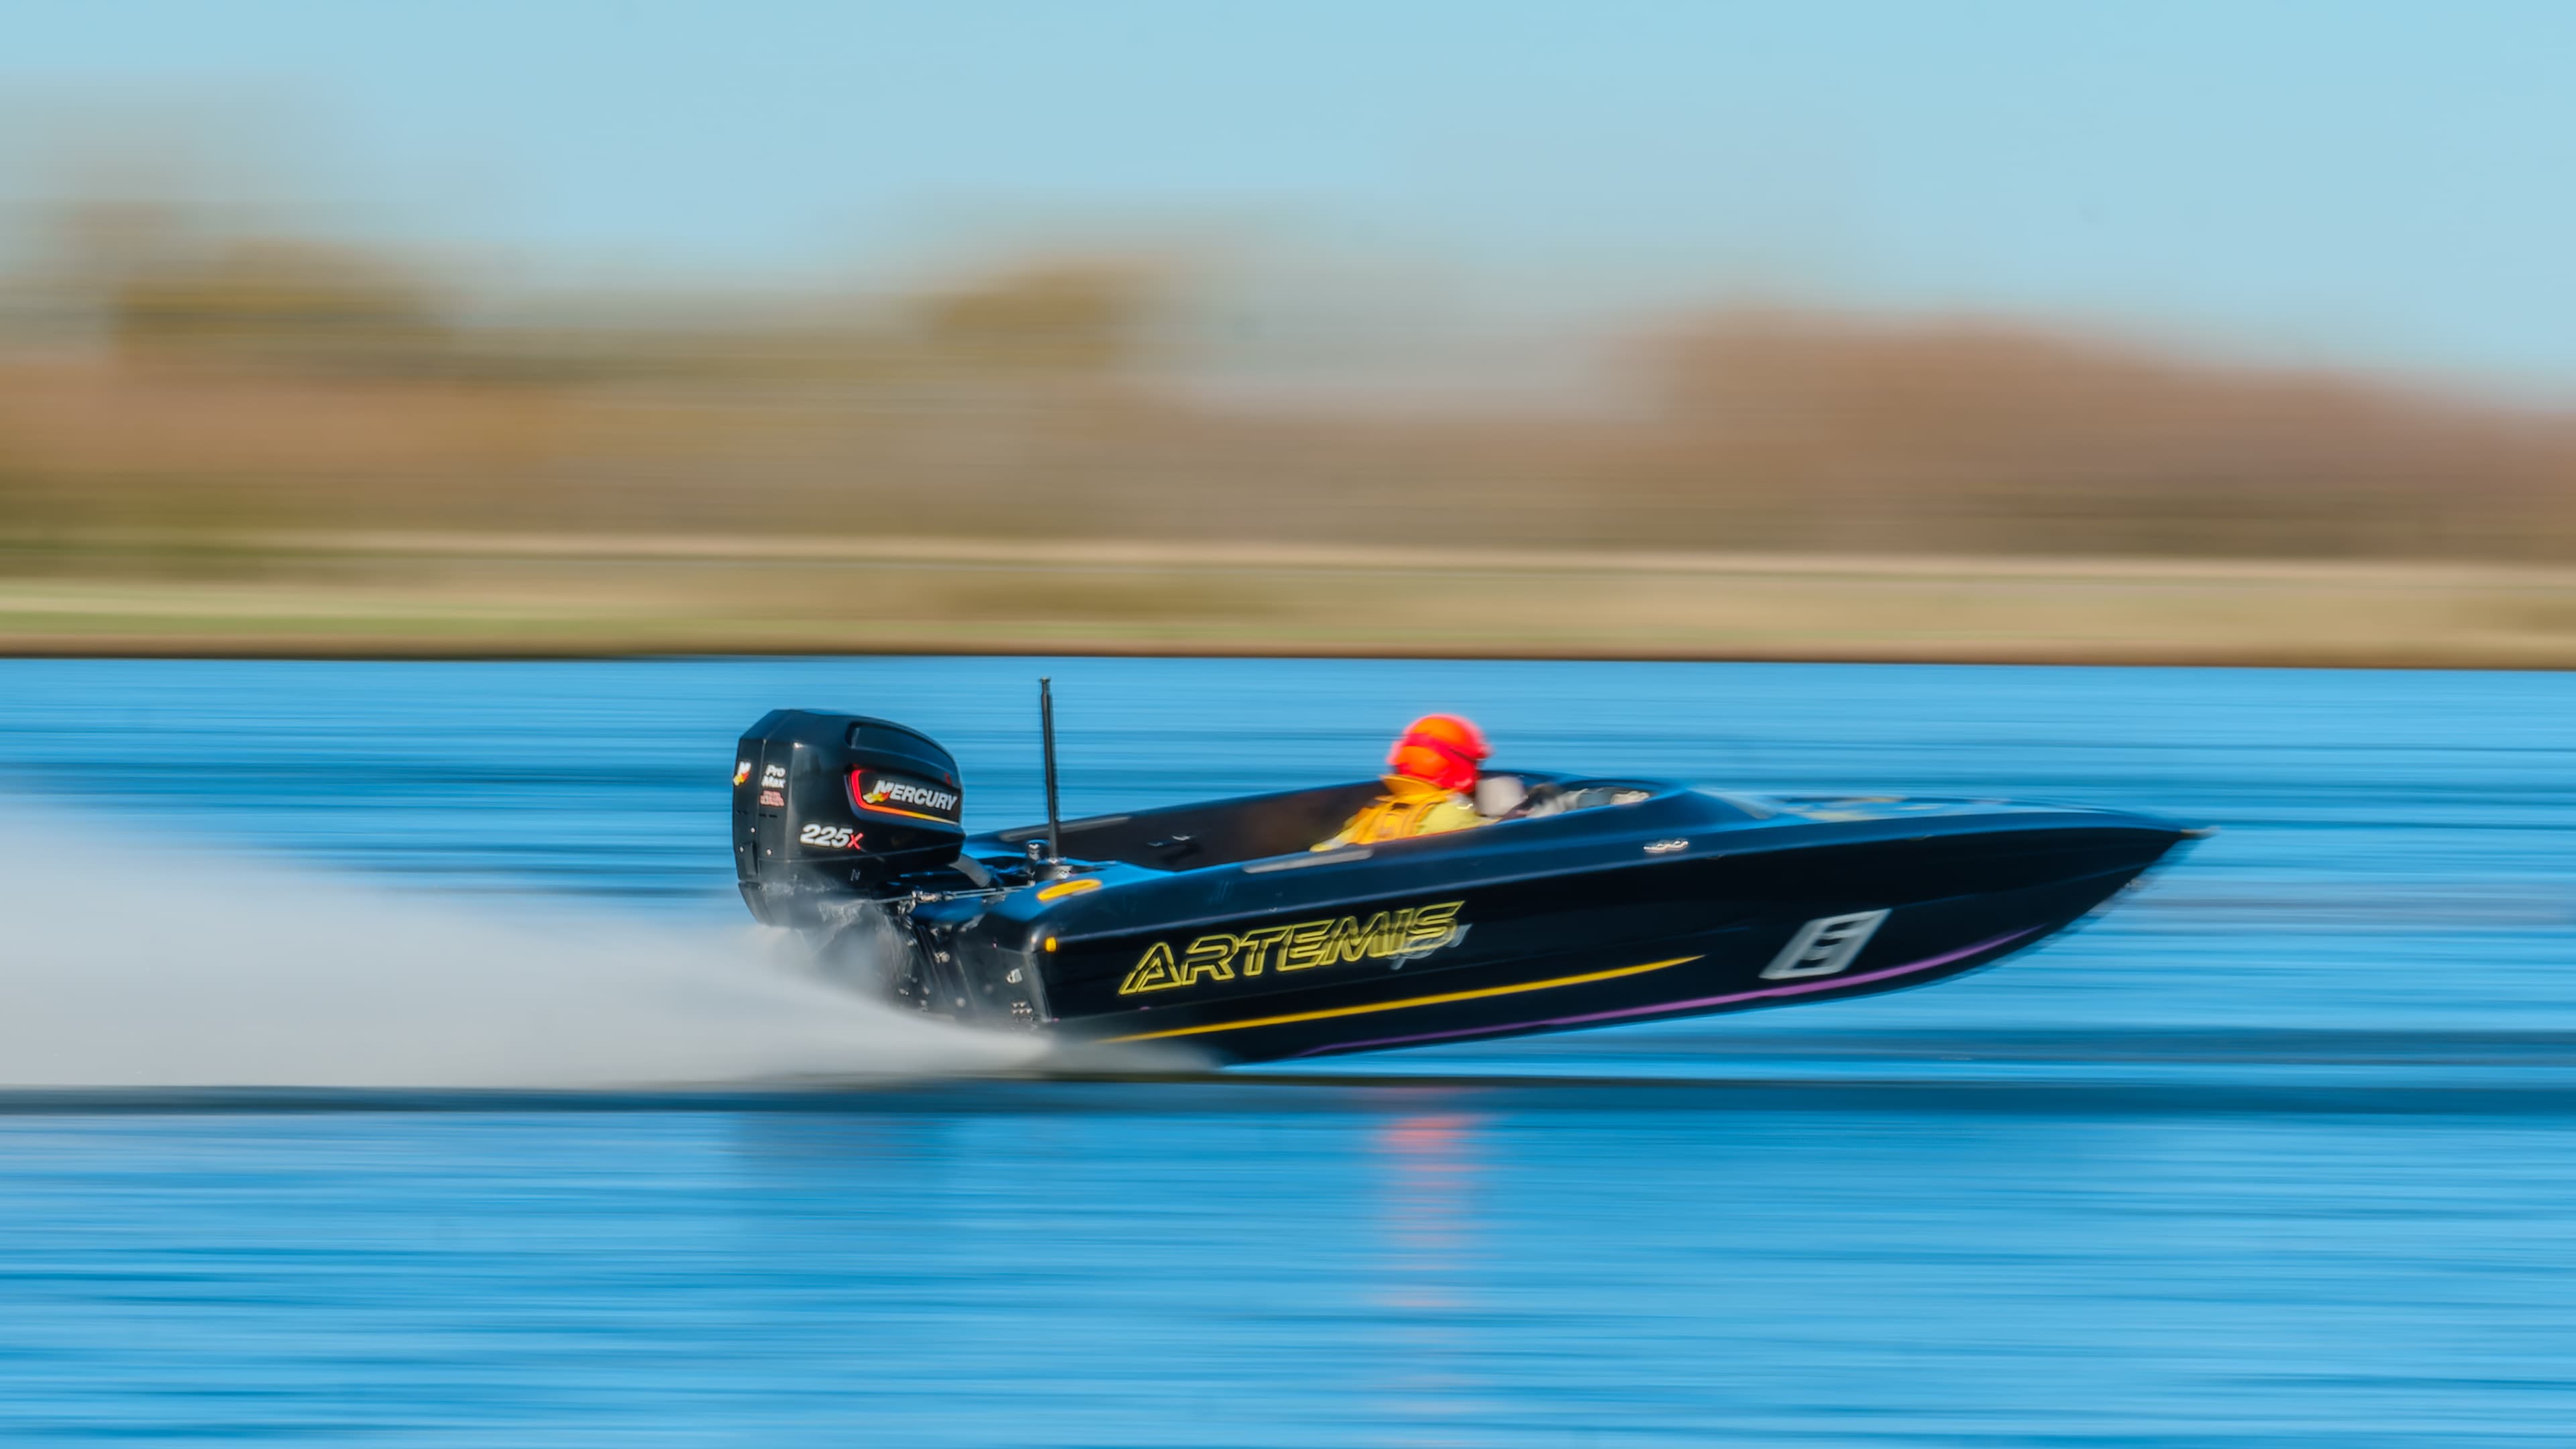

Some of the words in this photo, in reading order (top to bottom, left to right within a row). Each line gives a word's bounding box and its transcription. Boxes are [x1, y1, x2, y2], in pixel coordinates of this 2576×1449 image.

[765, 764, 786, 777] Pro
[761, 775, 786, 788] Max
[872, 780, 957, 810] MERCURY
[1118, 900, 1465, 996] ARTEMIS
